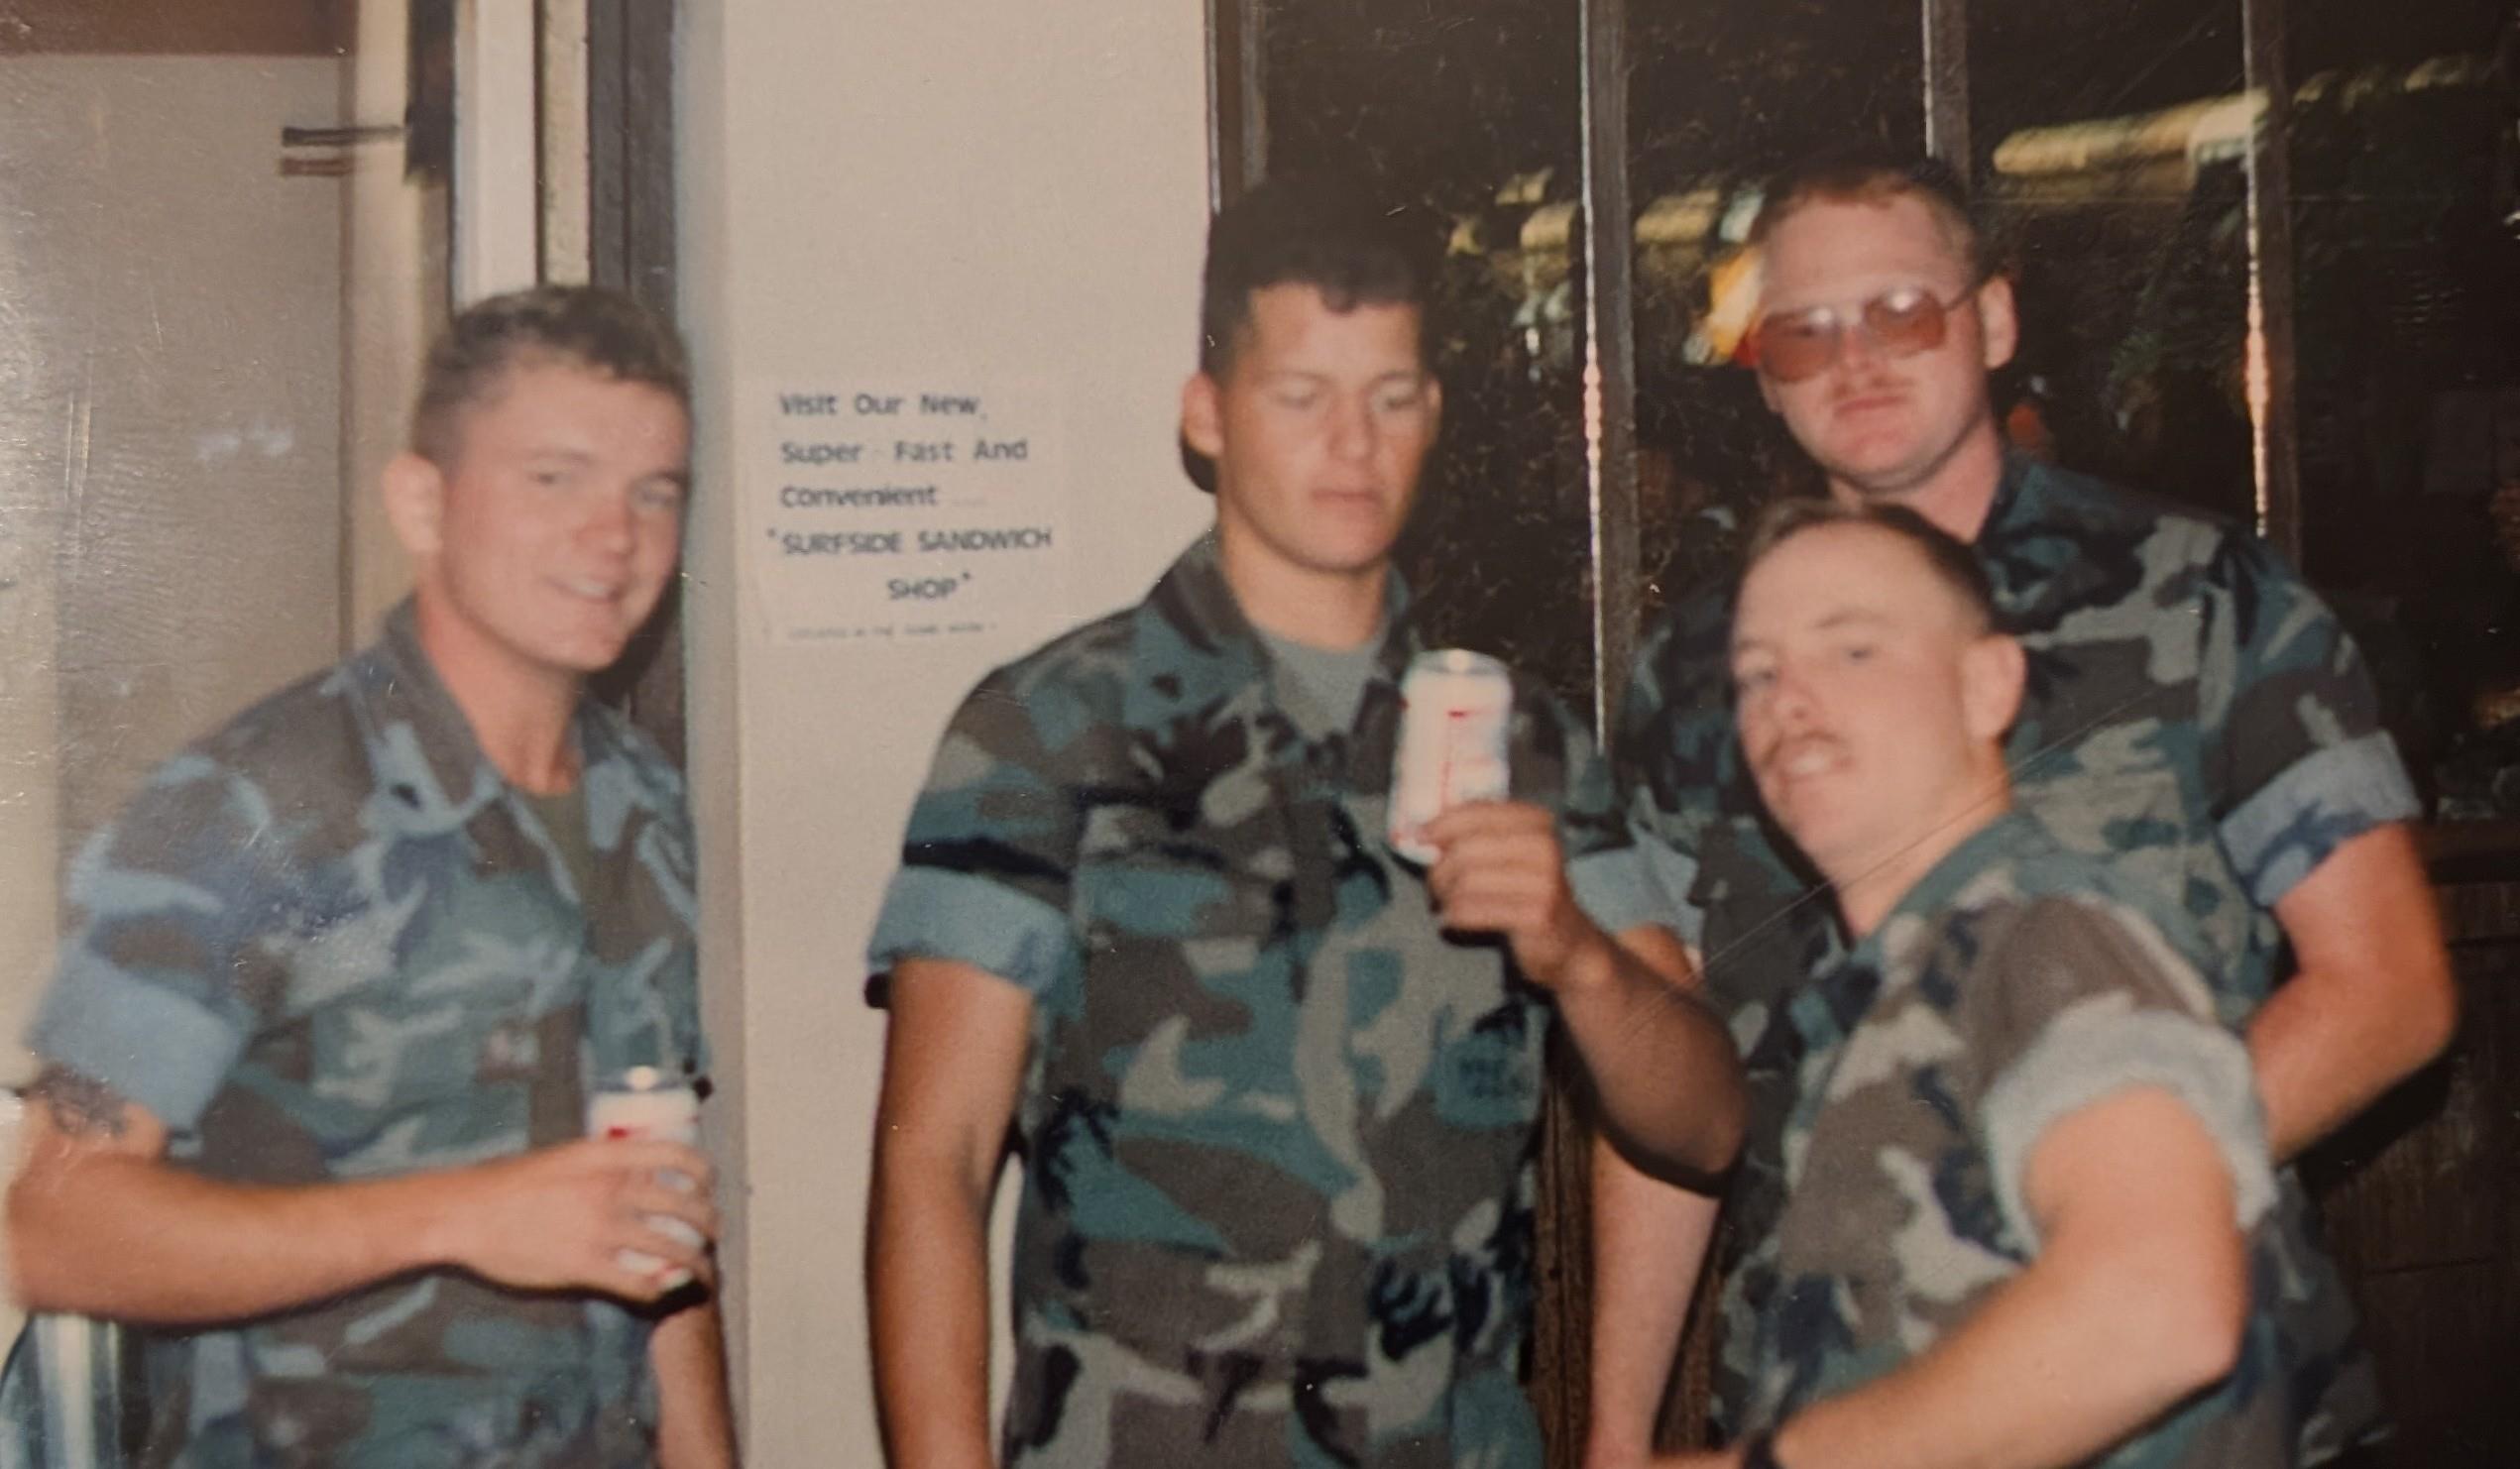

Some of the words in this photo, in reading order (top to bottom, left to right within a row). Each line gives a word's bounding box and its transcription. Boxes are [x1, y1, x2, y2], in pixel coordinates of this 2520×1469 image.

[854, 394, 903, 415] Our
[894, 440, 954, 462] Fast
[973, 439, 1029, 462] And
[779, 486, 940, 508] Convenient
[917, 526, 1053, 551] SANDWICH
